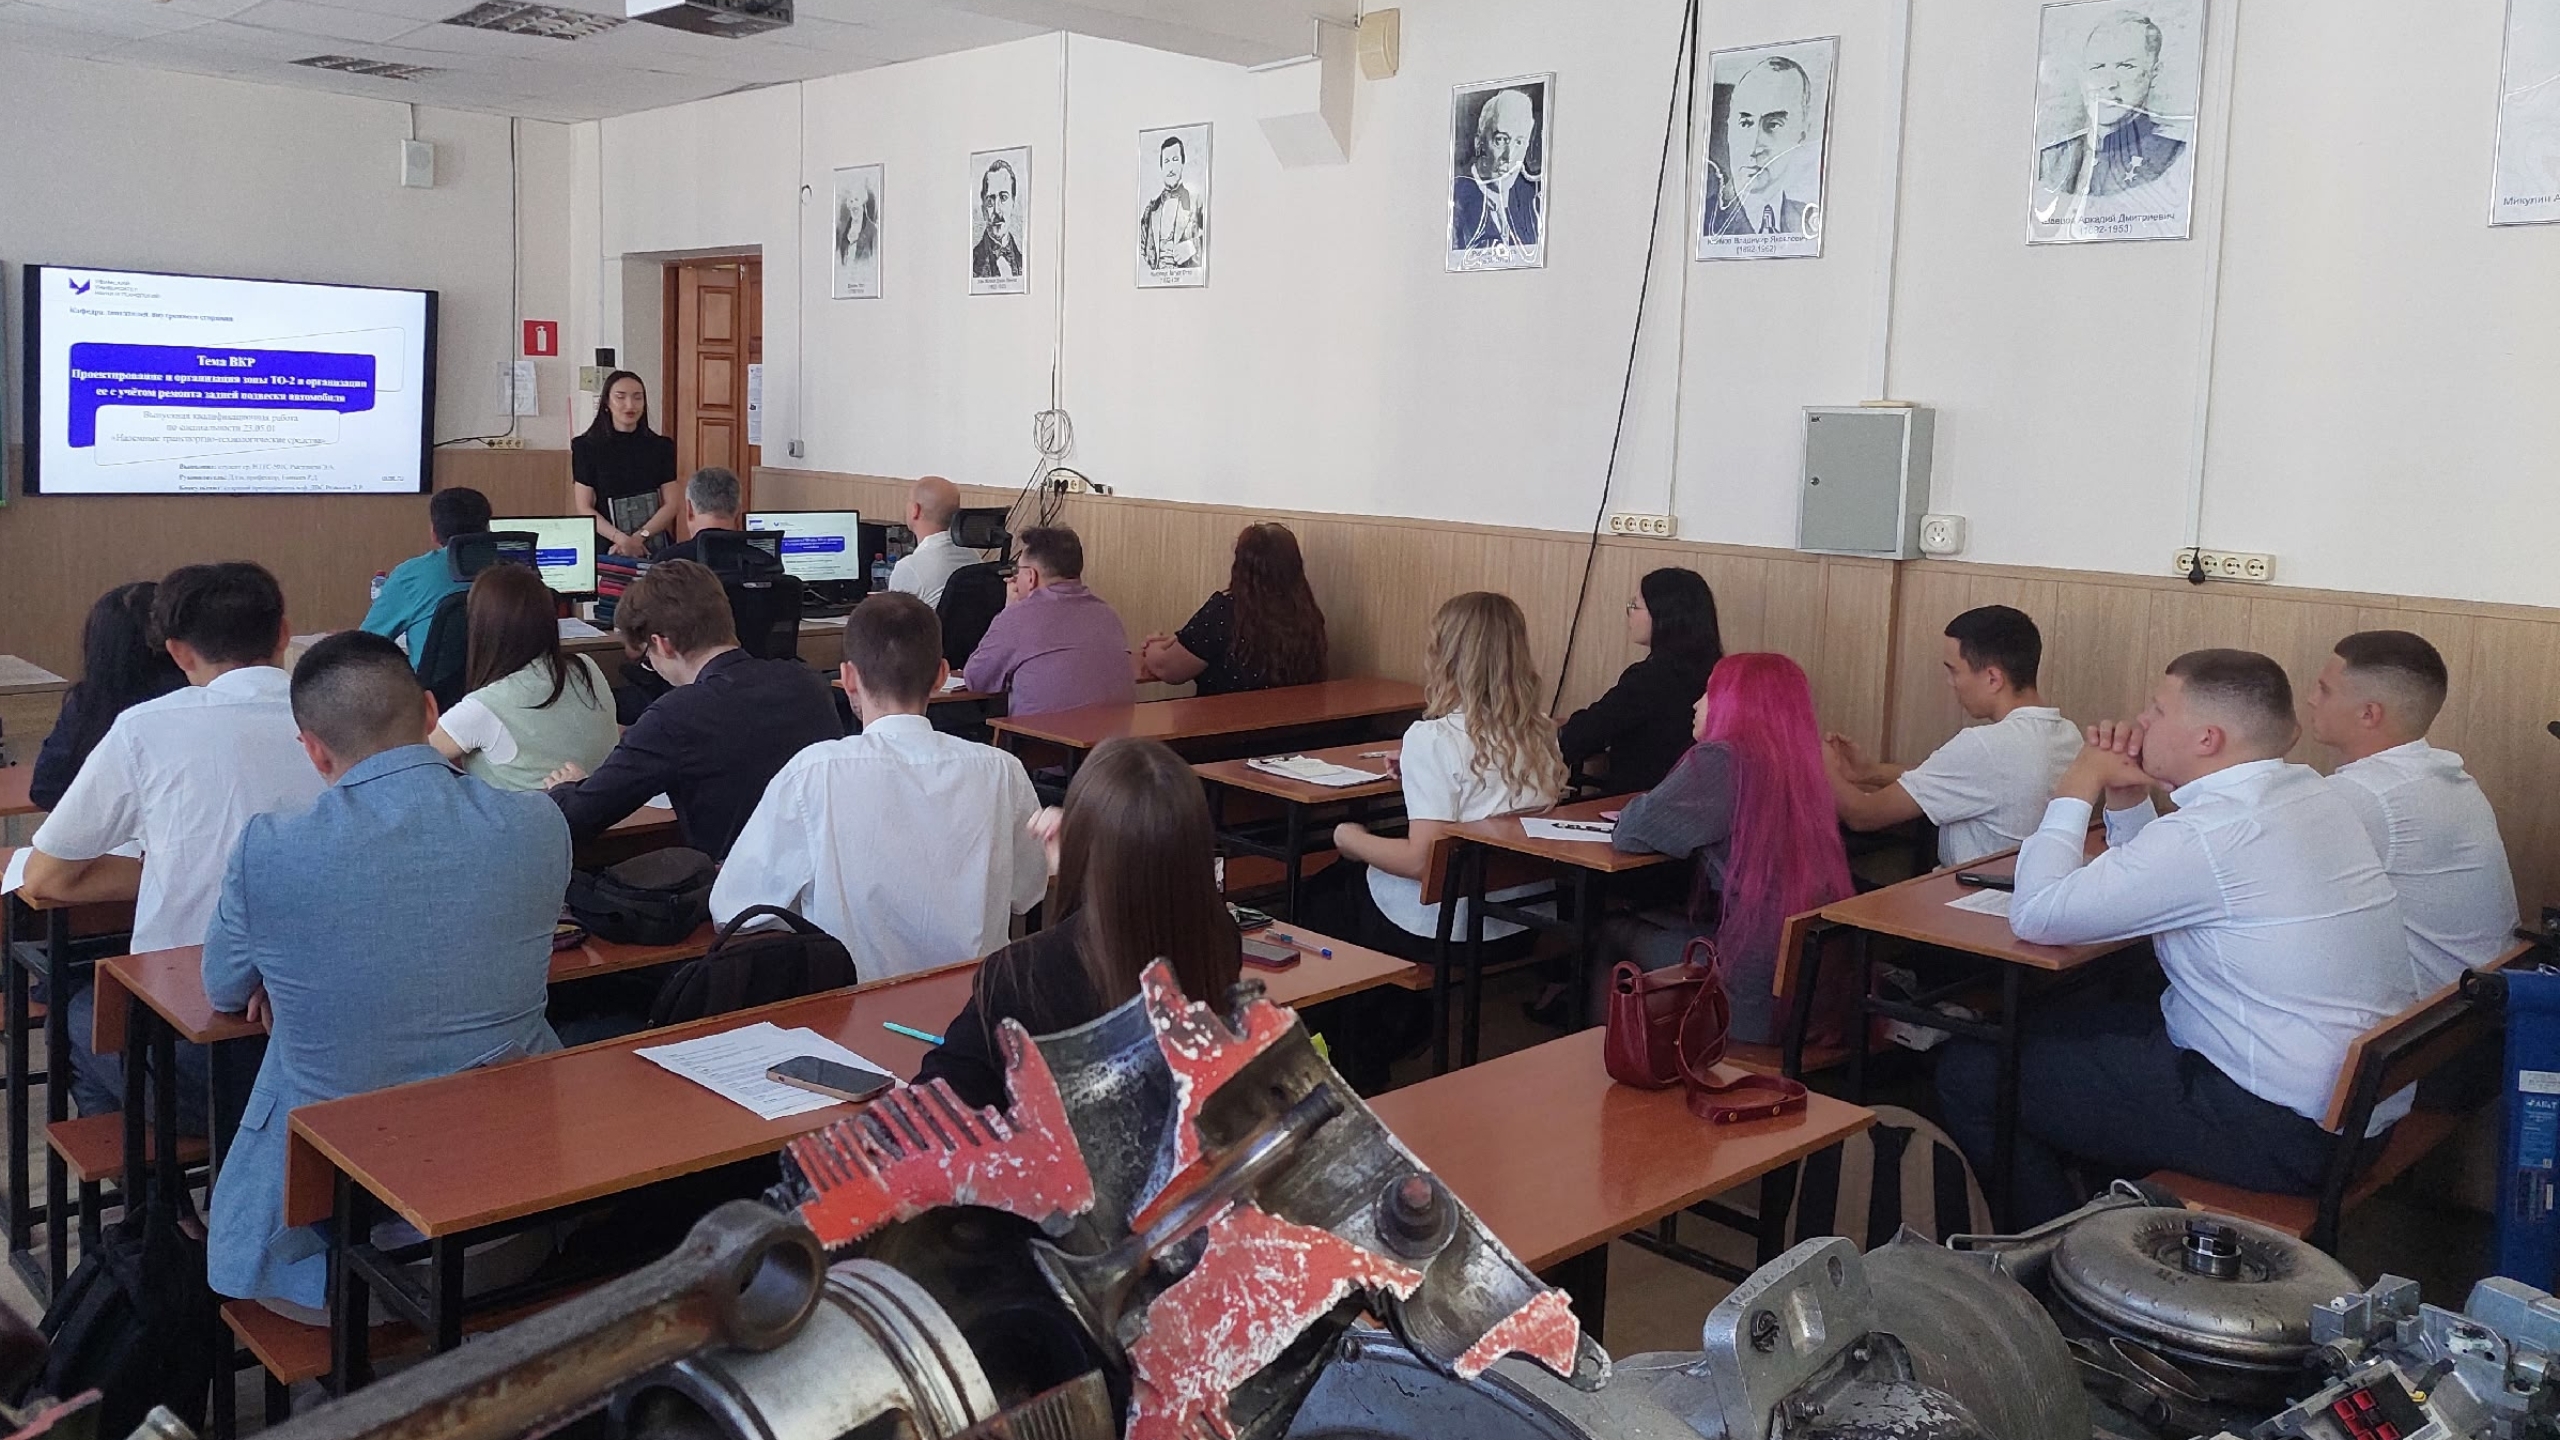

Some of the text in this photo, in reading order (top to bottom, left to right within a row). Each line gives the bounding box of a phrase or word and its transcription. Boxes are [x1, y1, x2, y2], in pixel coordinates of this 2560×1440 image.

[2503, 196, 2551, 206] Микулин
[2079, 213, 2116, 224] Аркадий
[2118, 213, 2175, 223] Дмитриевич
[196, 354, 256, 367] Тема ВКР
[72, 368, 163, 381] Проектирование
[242, 376, 268, 385] зоны
[270, 375, 296, 386] ТО-2
[297, 378, 304, 386] и
[95, 388, 109, 396] ее
[118, 386, 157, 399] учётом
[158, 389, 202, 400] ремонта
[204, 390, 239, 399] задней
[240, 391, 287, 401] подвески
[288, 392, 346, 403] автомобиля
[272, 413, 299, 422] работа
